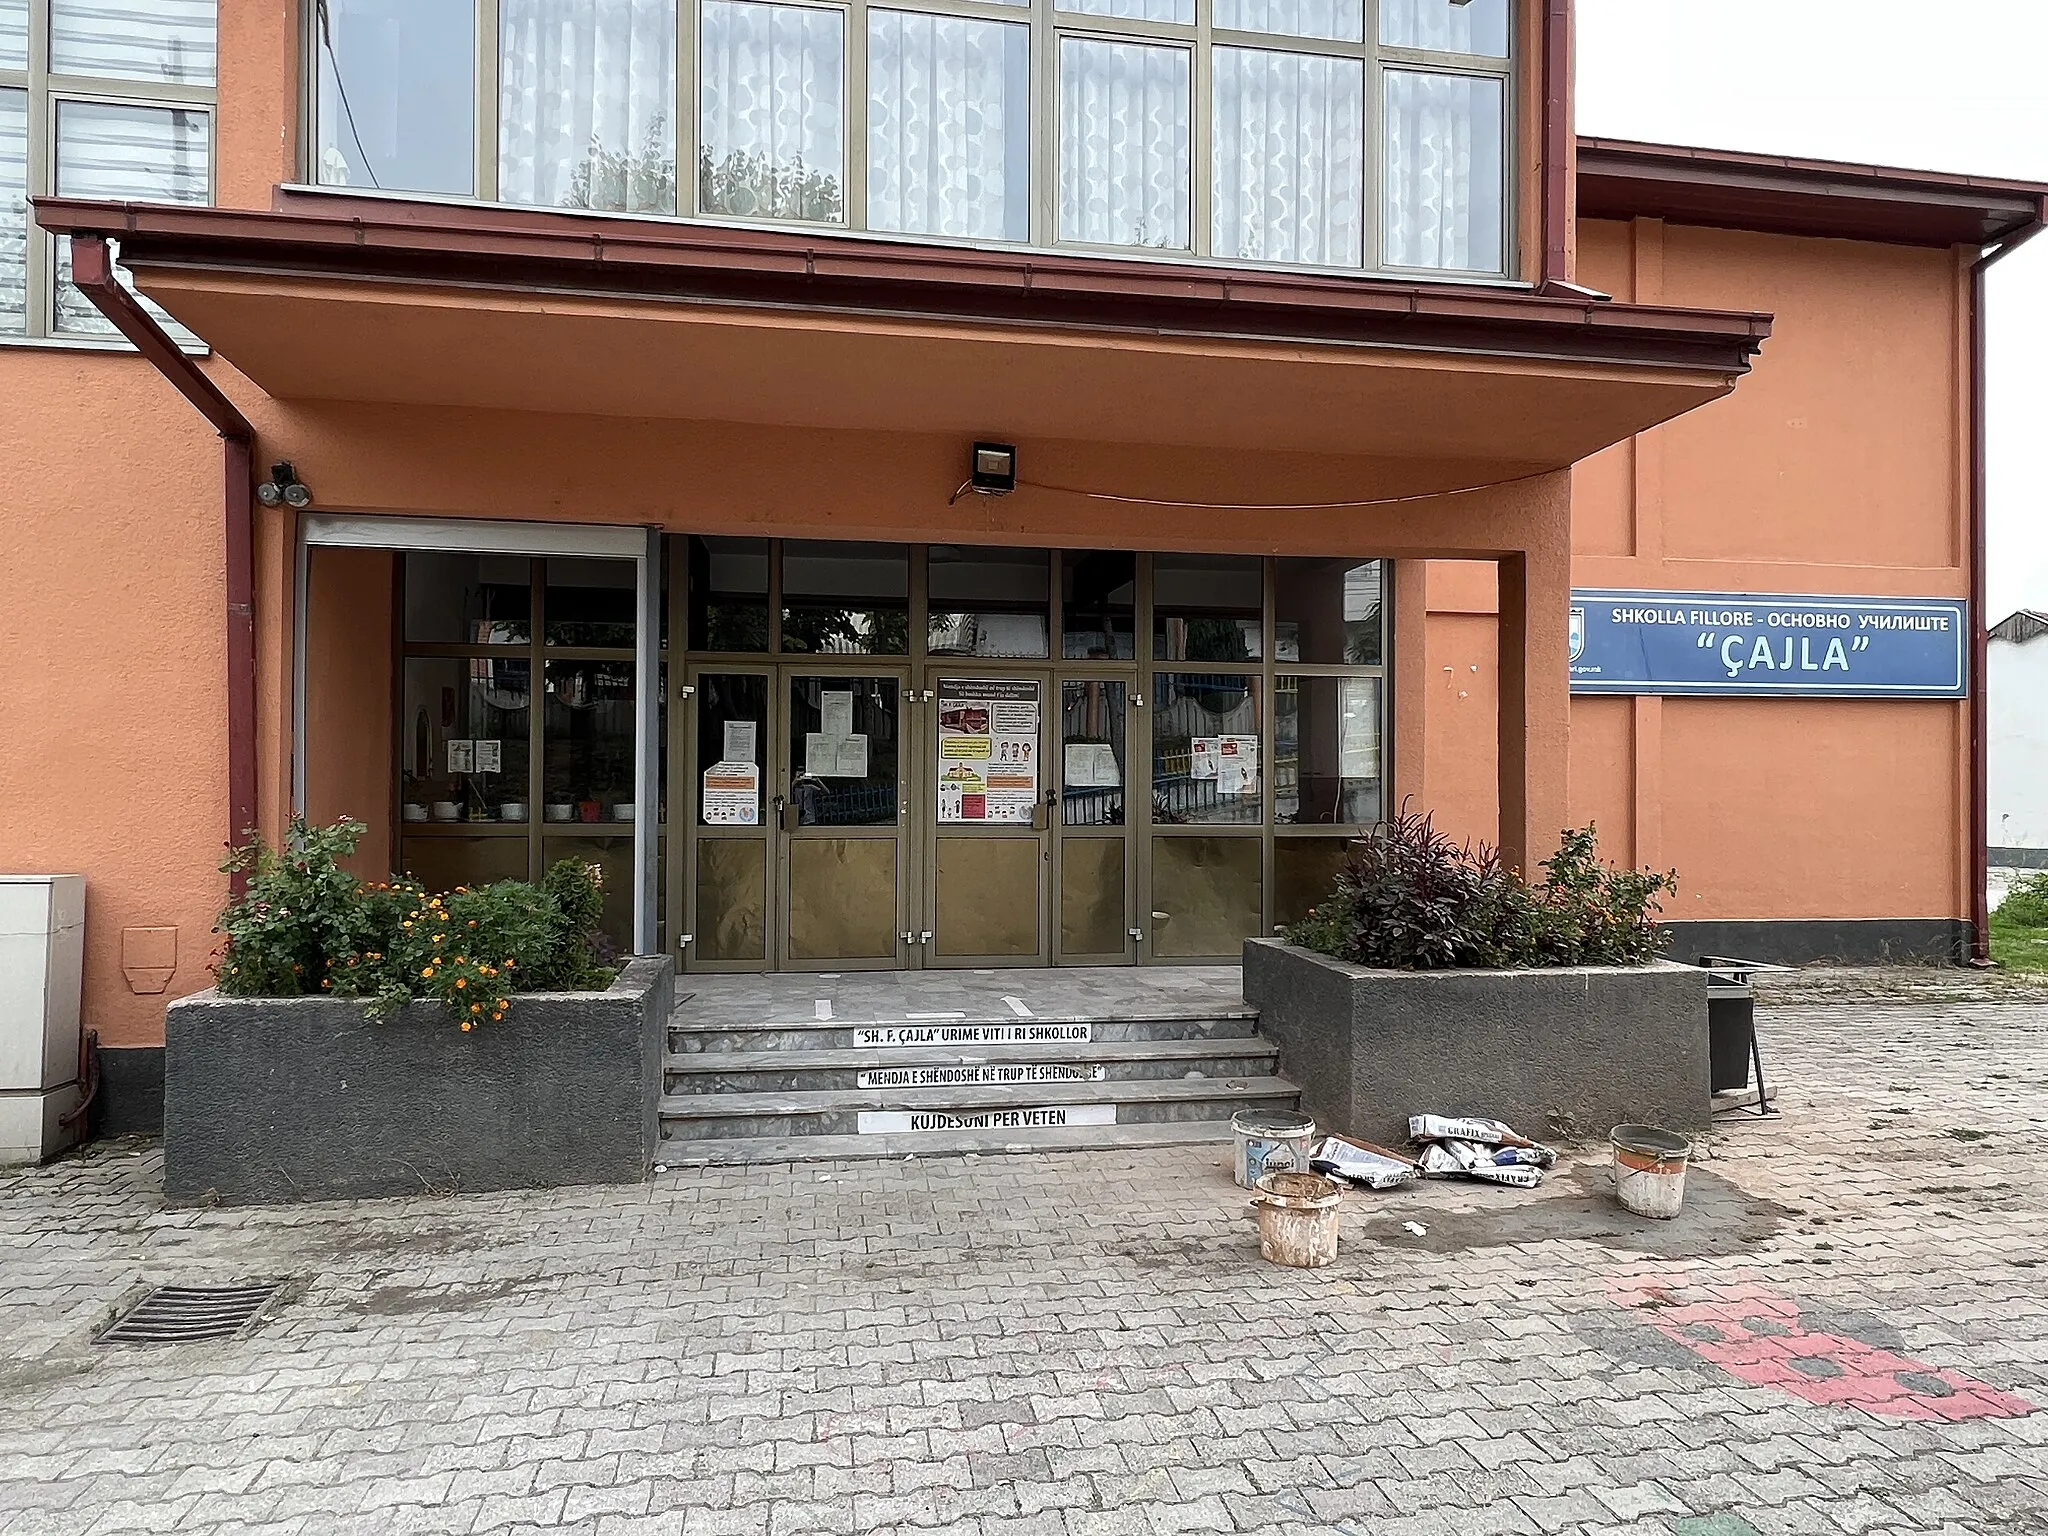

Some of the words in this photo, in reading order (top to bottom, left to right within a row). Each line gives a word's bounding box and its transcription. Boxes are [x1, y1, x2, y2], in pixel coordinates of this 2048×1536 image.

[1611, 608, 1687, 625] SHKOLLA
[1690, 610, 1753, 627] FILLORE
[1767, 612, 1851, 629] ОСНОВНО
[1858, 615, 1950, 632] УЧИЛИШТЕ
[1696, 632, 1871, 678] “ÇAJLA”
[942, 1028, 980, 1042] URIME
[983, 1027, 1005, 1041] VITI
[1008, 1027, 1012, 1040] I
[1015, 1027, 1027, 1040] RI
[1029, 1026, 1088, 1040] SHKOLLOR
[912, 1070, 918, 1084] E
[919, 1066, 979, 1084] SHËNDOSHË
[983, 1065, 995, 1081] NË
[997, 1068, 1024, 1081] TRUP
[1026, 1064, 1037, 1080] TË
[993, 1112, 1020, 1127] PER
[1022, 1110, 1066, 1126] VETEN
